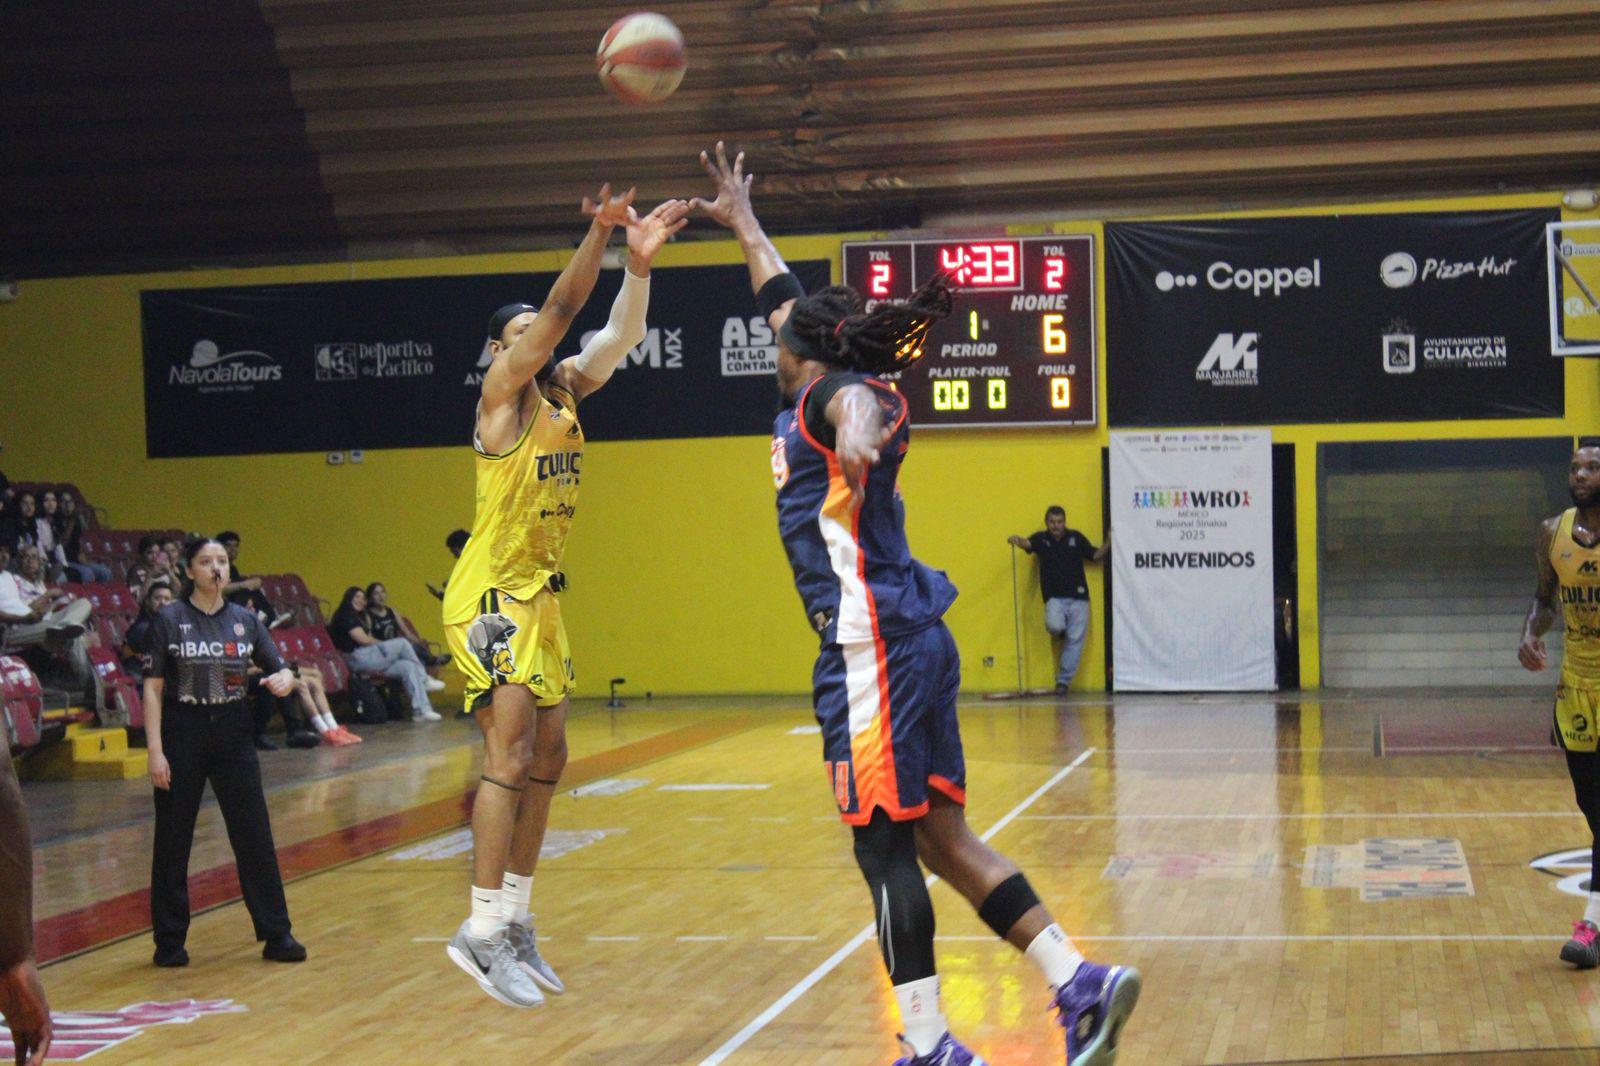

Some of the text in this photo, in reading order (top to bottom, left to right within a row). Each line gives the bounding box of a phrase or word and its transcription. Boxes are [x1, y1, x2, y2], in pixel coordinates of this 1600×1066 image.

[869, 251, 891, 261] TOL
[1044, 246, 1065, 256] TOL
[942, 245, 1015, 284] 4:33
[1421, 256, 1518, 281] Pizza Hut
[872, 264, 890, 293] 2
[1046, 260, 1064, 289] 2
[1206, 258, 1321, 296] Coppel
[1011, 295, 1068, 311] HOME
[722, 316, 778, 346] AS
[970, 310, 979, 340] 1
[1043, 315, 1067, 354] 6
[1423, 336, 1506, 346] AYUNTAMIENTO DE
[727, 349, 766, 361] ME LO
[941, 343, 998, 357] PERIOD
[727, 361, 776, 372] CONTAR
[928, 366, 1011, 379] PLAYER-FOUL
[1038, 365, 1075, 376] FOULS
[1196, 369, 1258, 381] MANJARREZ
[934, 381, 969, 410] 00
[988, 379, 1006, 409] 0
[1051, 377, 1070, 408] 0
[1190, 490, 1241, 508] WRO
[1156, 519, 1227, 529] Regional Sinaloa
[1180, 530, 1206, 540] 2025
[1134, 552, 1255, 569] BIENVENIDOS
